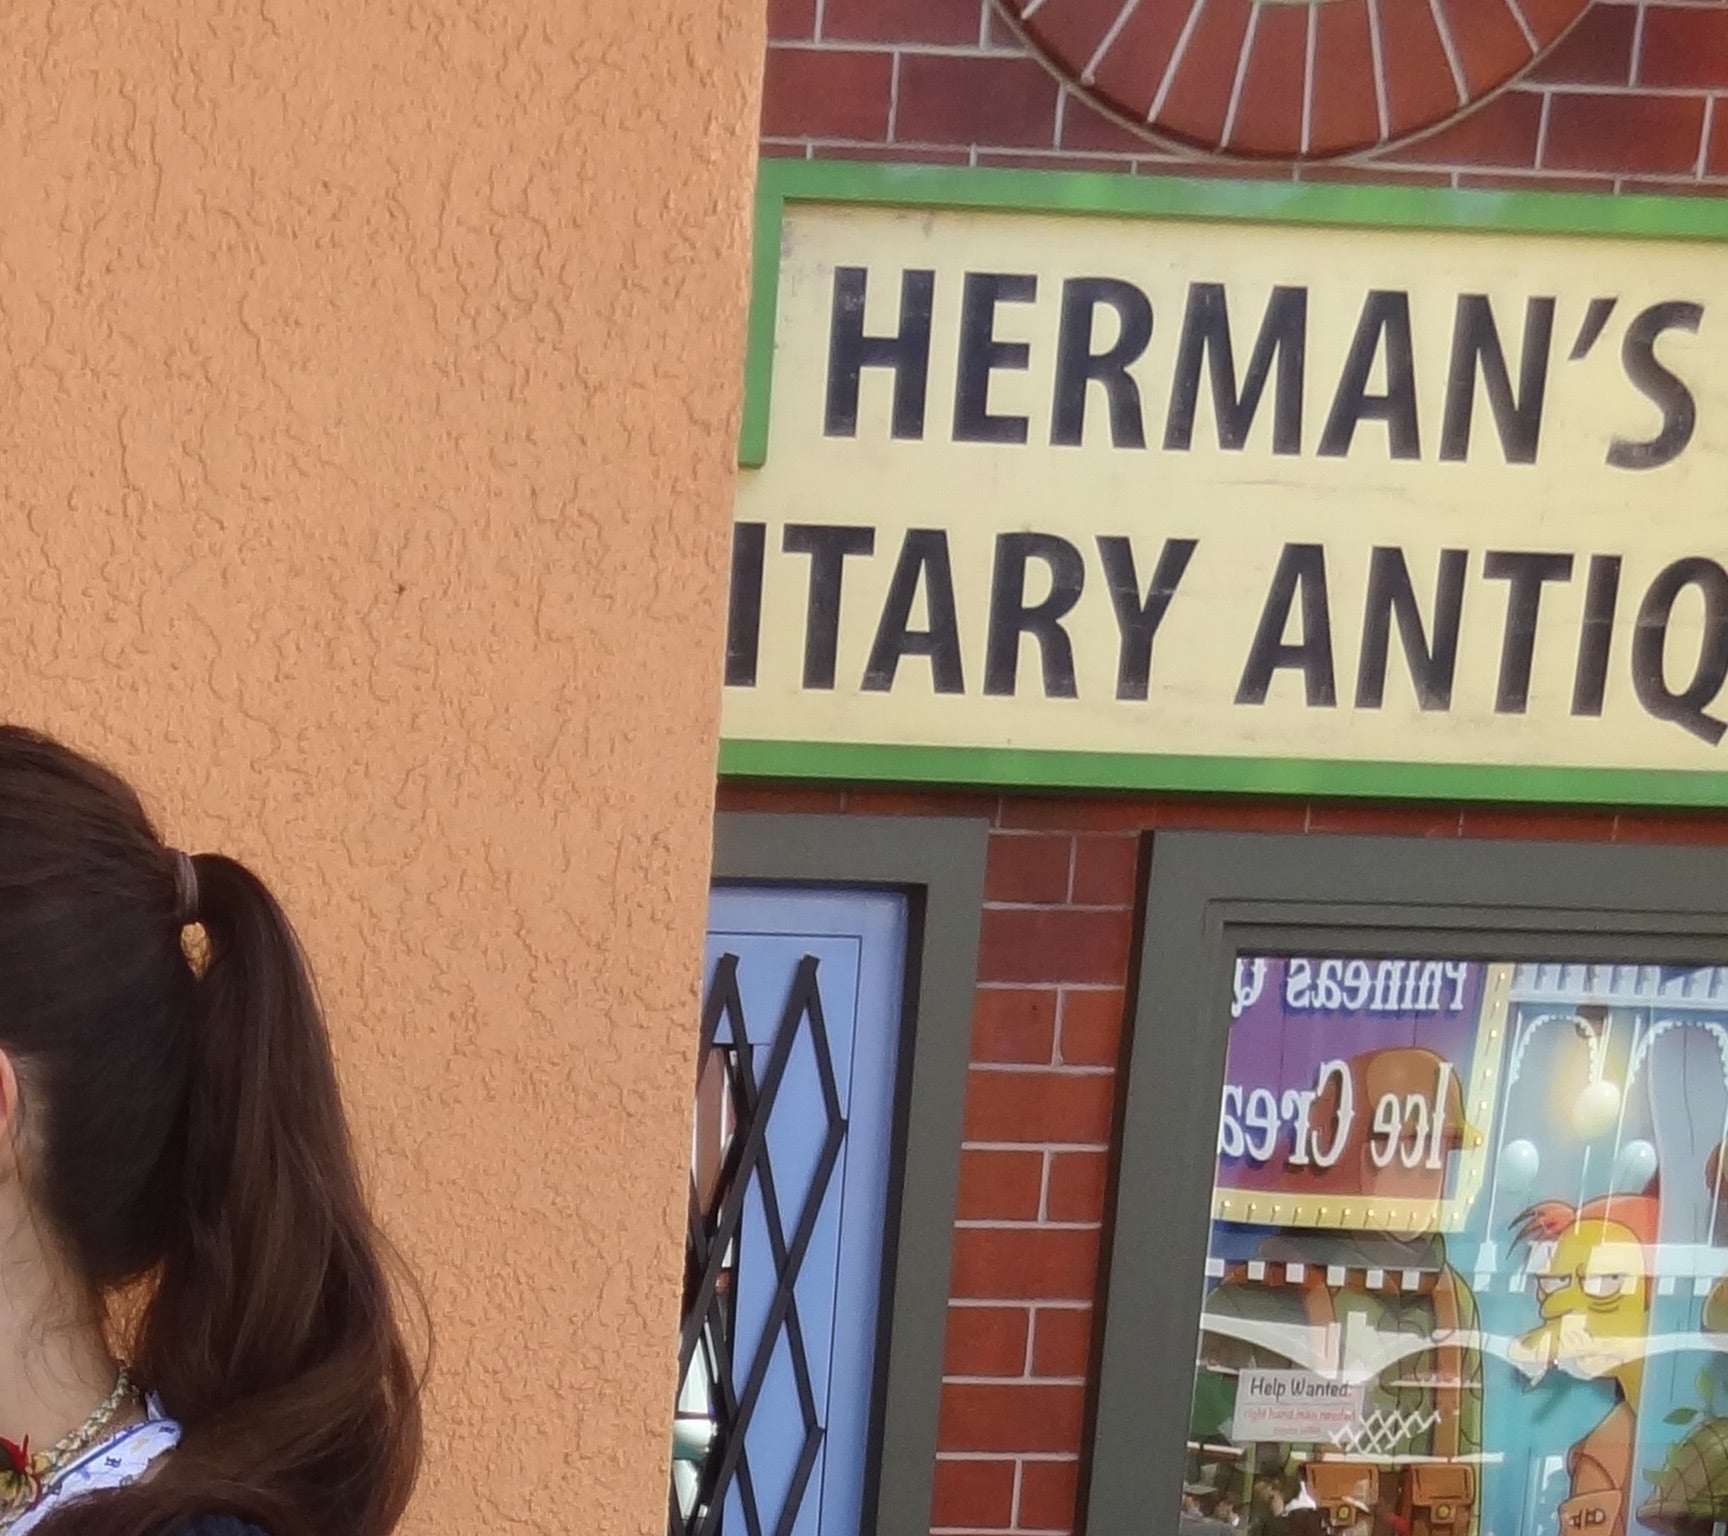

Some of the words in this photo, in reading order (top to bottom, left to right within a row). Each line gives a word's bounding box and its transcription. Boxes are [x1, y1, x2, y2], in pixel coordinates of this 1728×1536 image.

[823, 266, 1705, 472] HERMAN'S
[723, 521, 1199, 702] ITARY
[1234, 541, 1728, 747] ANTIQ
[1250, 1376, 1286, 1402] Help
